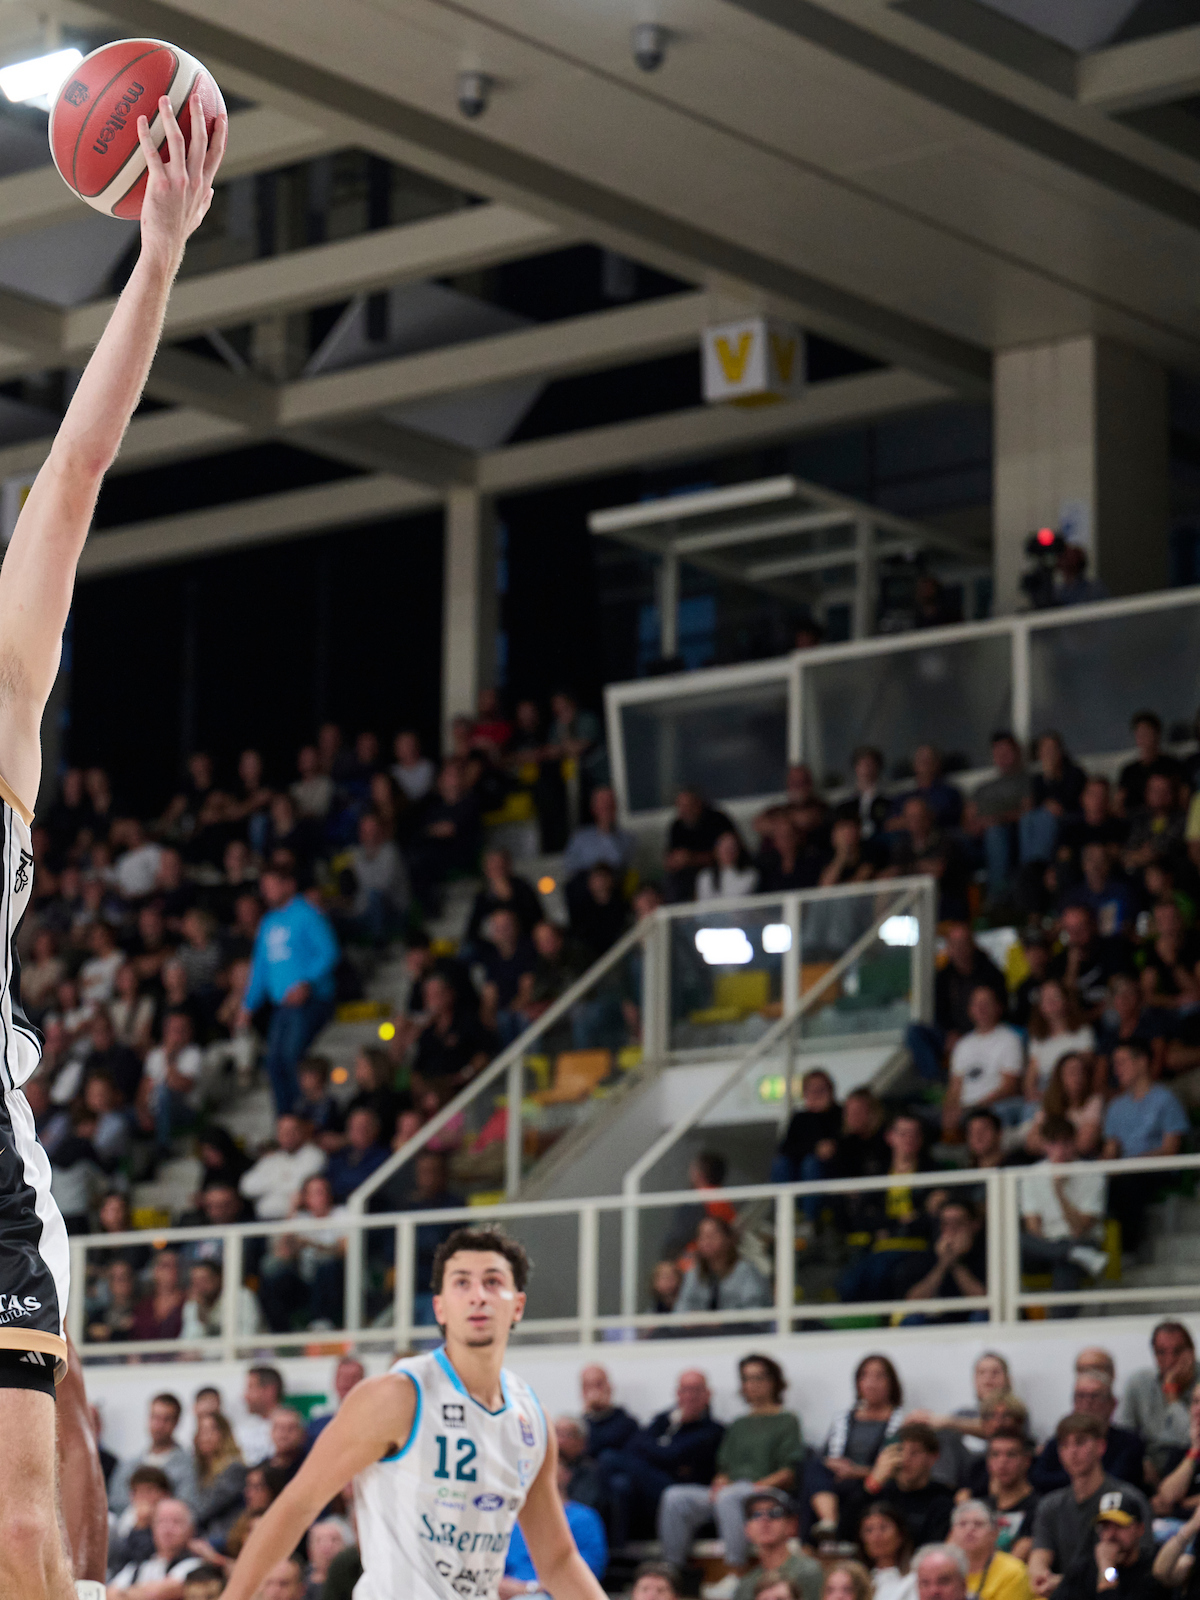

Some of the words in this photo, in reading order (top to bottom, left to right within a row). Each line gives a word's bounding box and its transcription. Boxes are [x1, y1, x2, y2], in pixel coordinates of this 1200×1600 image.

[92, 81, 145, 155] molten
[714, 331, 753, 384] V
[433, 1435, 478, 1482] 12
